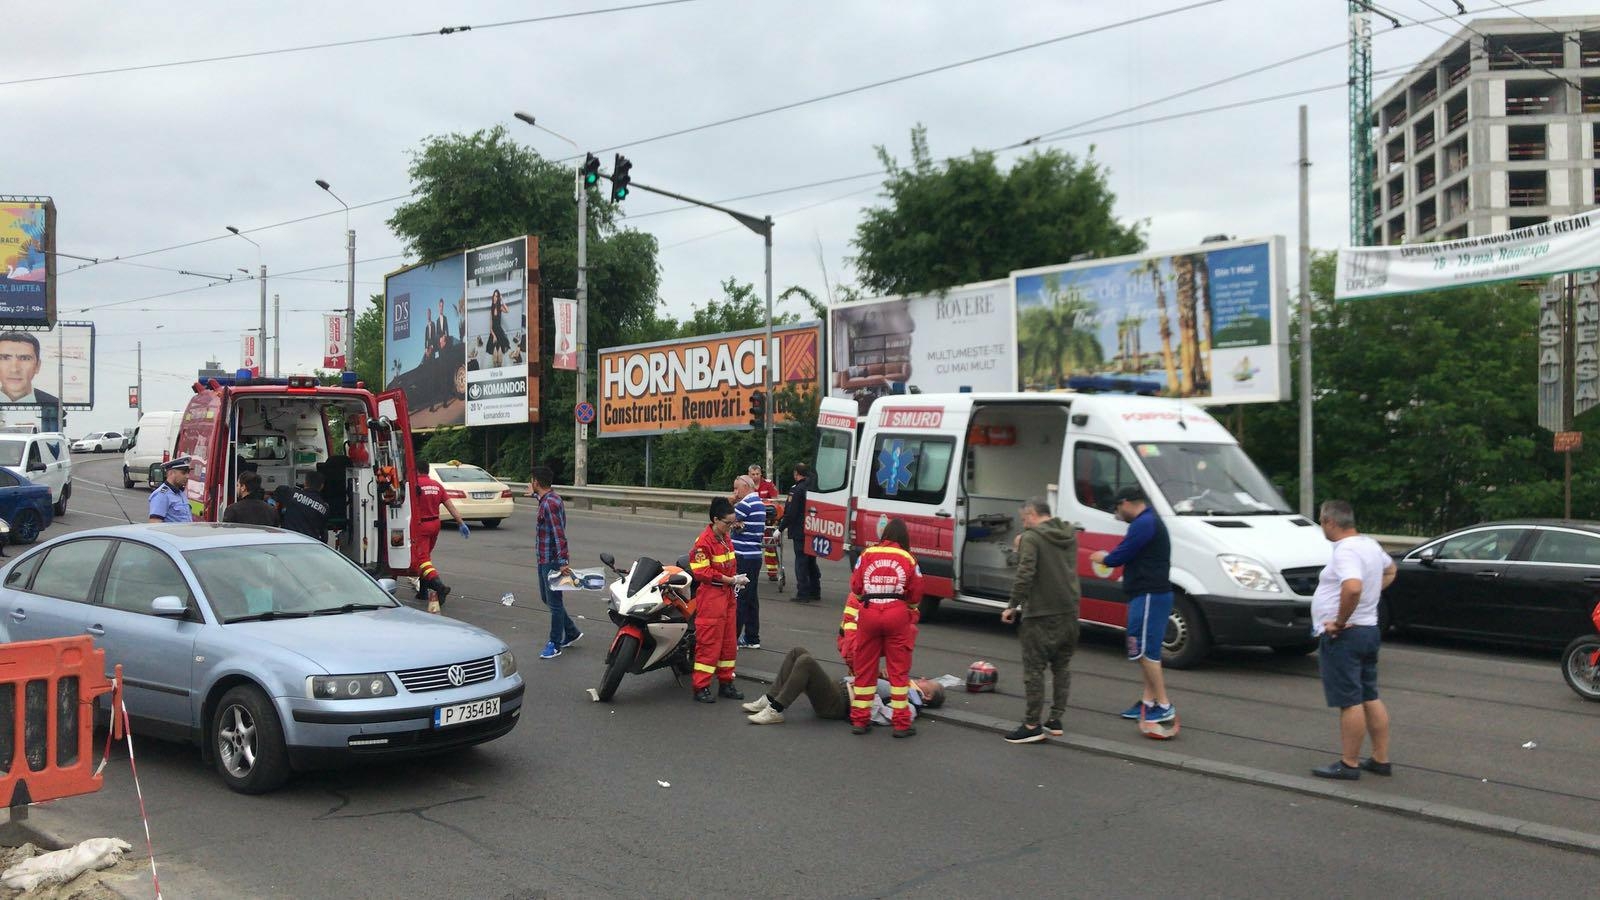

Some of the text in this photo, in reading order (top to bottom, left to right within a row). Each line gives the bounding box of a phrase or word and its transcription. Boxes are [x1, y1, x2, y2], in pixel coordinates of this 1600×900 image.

[1537, 225, 1552, 236] DE
[11, 284, 41, 292] BUFTEA
[1098, 280, 1120, 299] de
[936, 293, 995, 320] ROVERE
[604, 337, 781, 398] HORNBACH
[936, 359, 997, 374] CU MAI MULT
[482, 381, 526, 396] KOMANDOR
[682, 392, 746, 421] Renovări.
[826, 416, 851, 428] SMURD
[892, 411, 941, 427] SMURD
[805, 516, 844, 538] SMURD
[812, 537, 830, 555] 112
[445, 708, 454, 723] P
